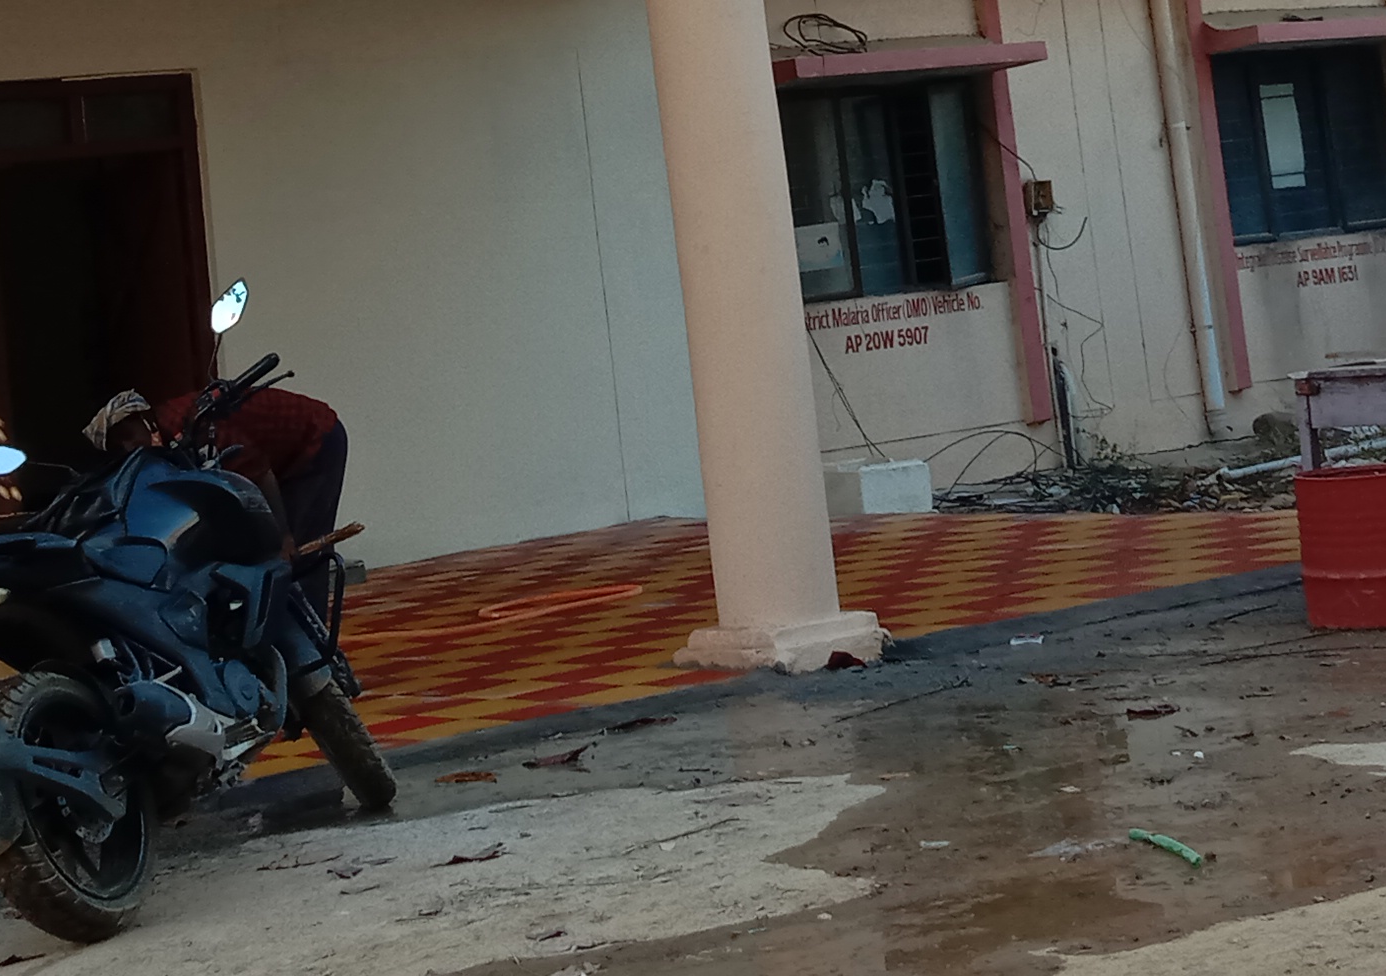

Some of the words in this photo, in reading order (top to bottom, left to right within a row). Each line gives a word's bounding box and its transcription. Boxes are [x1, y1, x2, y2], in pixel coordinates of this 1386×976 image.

[831, 307, 870, 328] Malaria
[870, 302, 902, 323] Officer
[902, 296, 931, 322] (DMO)
[931, 294, 965, 315] Vehicle
[845, 334, 862, 354] AP
[865, 330, 894, 352] 20W
[897, 326, 929, 347] 5907
